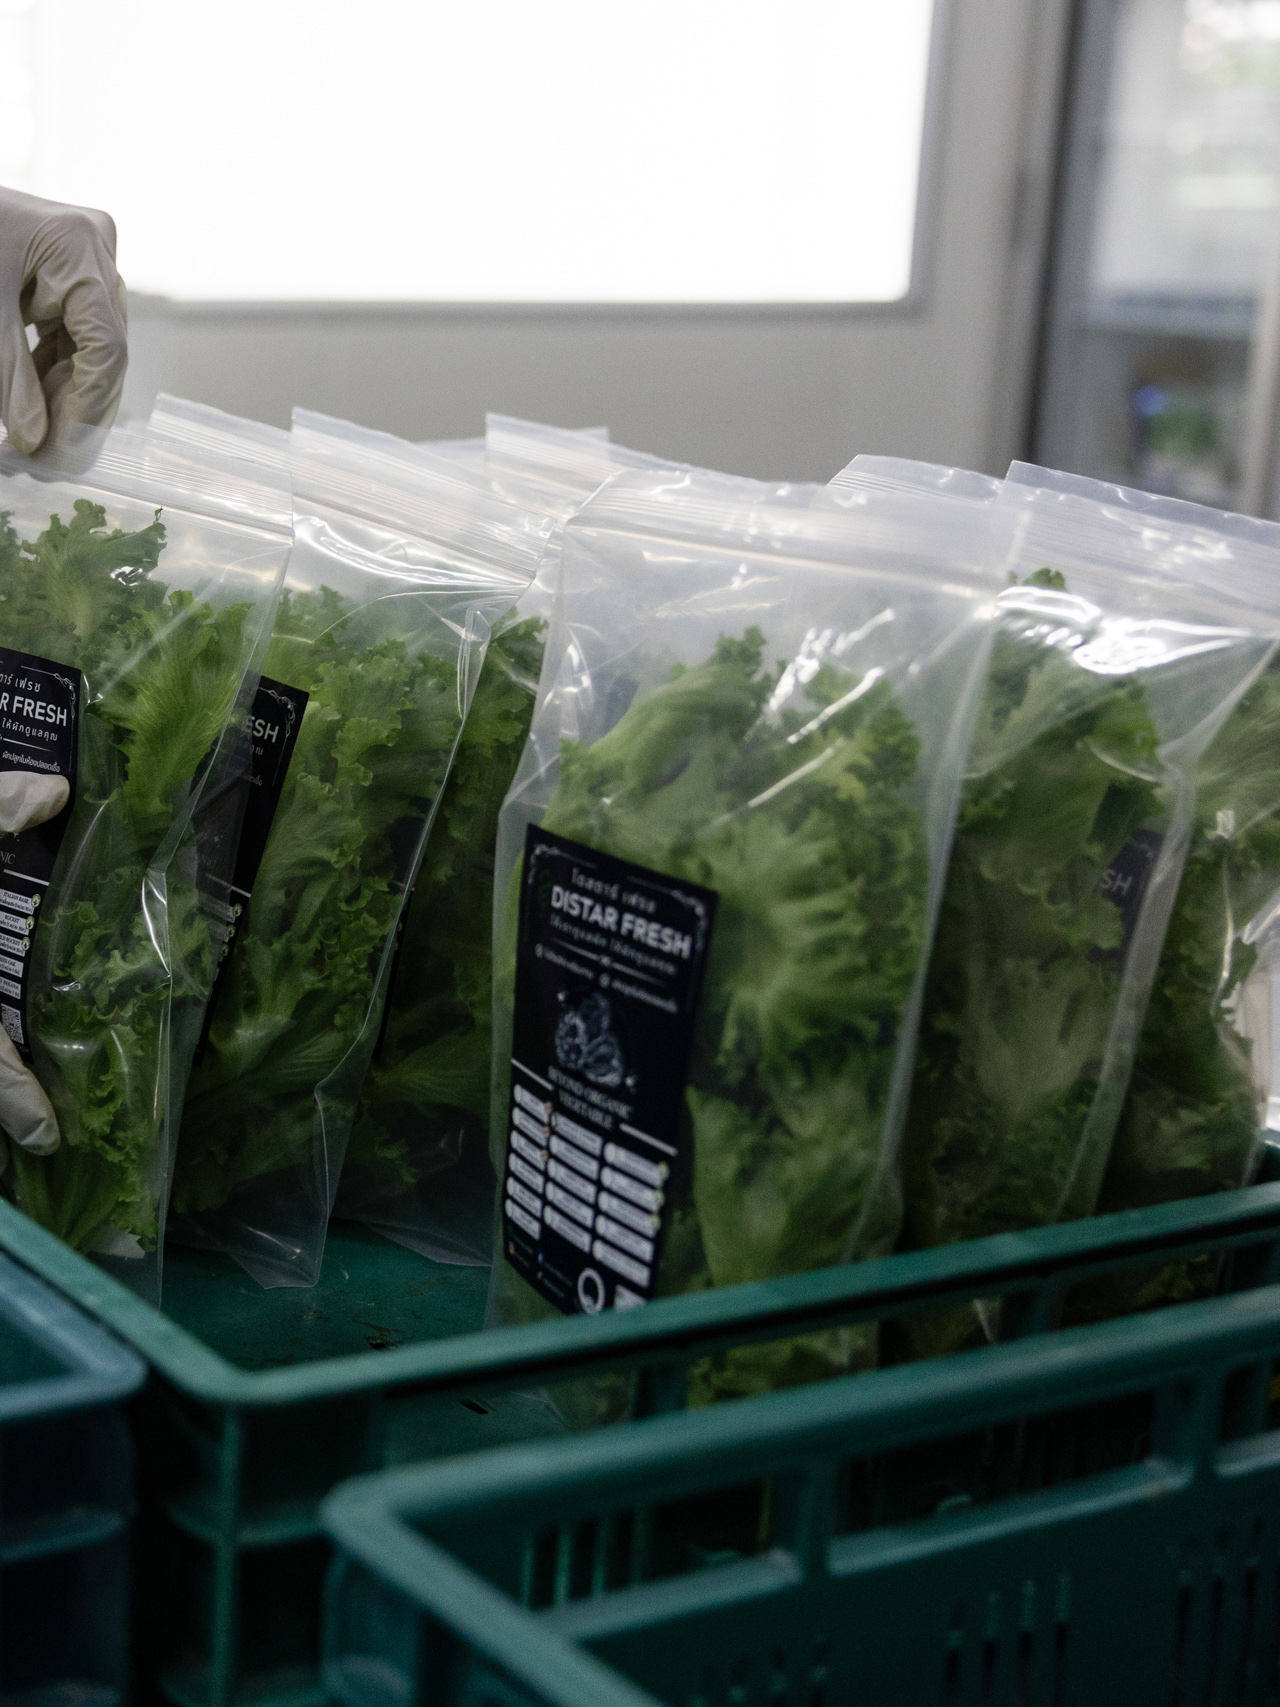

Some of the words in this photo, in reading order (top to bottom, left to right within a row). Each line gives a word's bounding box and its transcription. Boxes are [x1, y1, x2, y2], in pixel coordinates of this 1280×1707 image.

[12, 695, 68, 727] FRESH
[550, 884, 620, 933] DISTAR
[620, 911, 693, 960] FRESH
